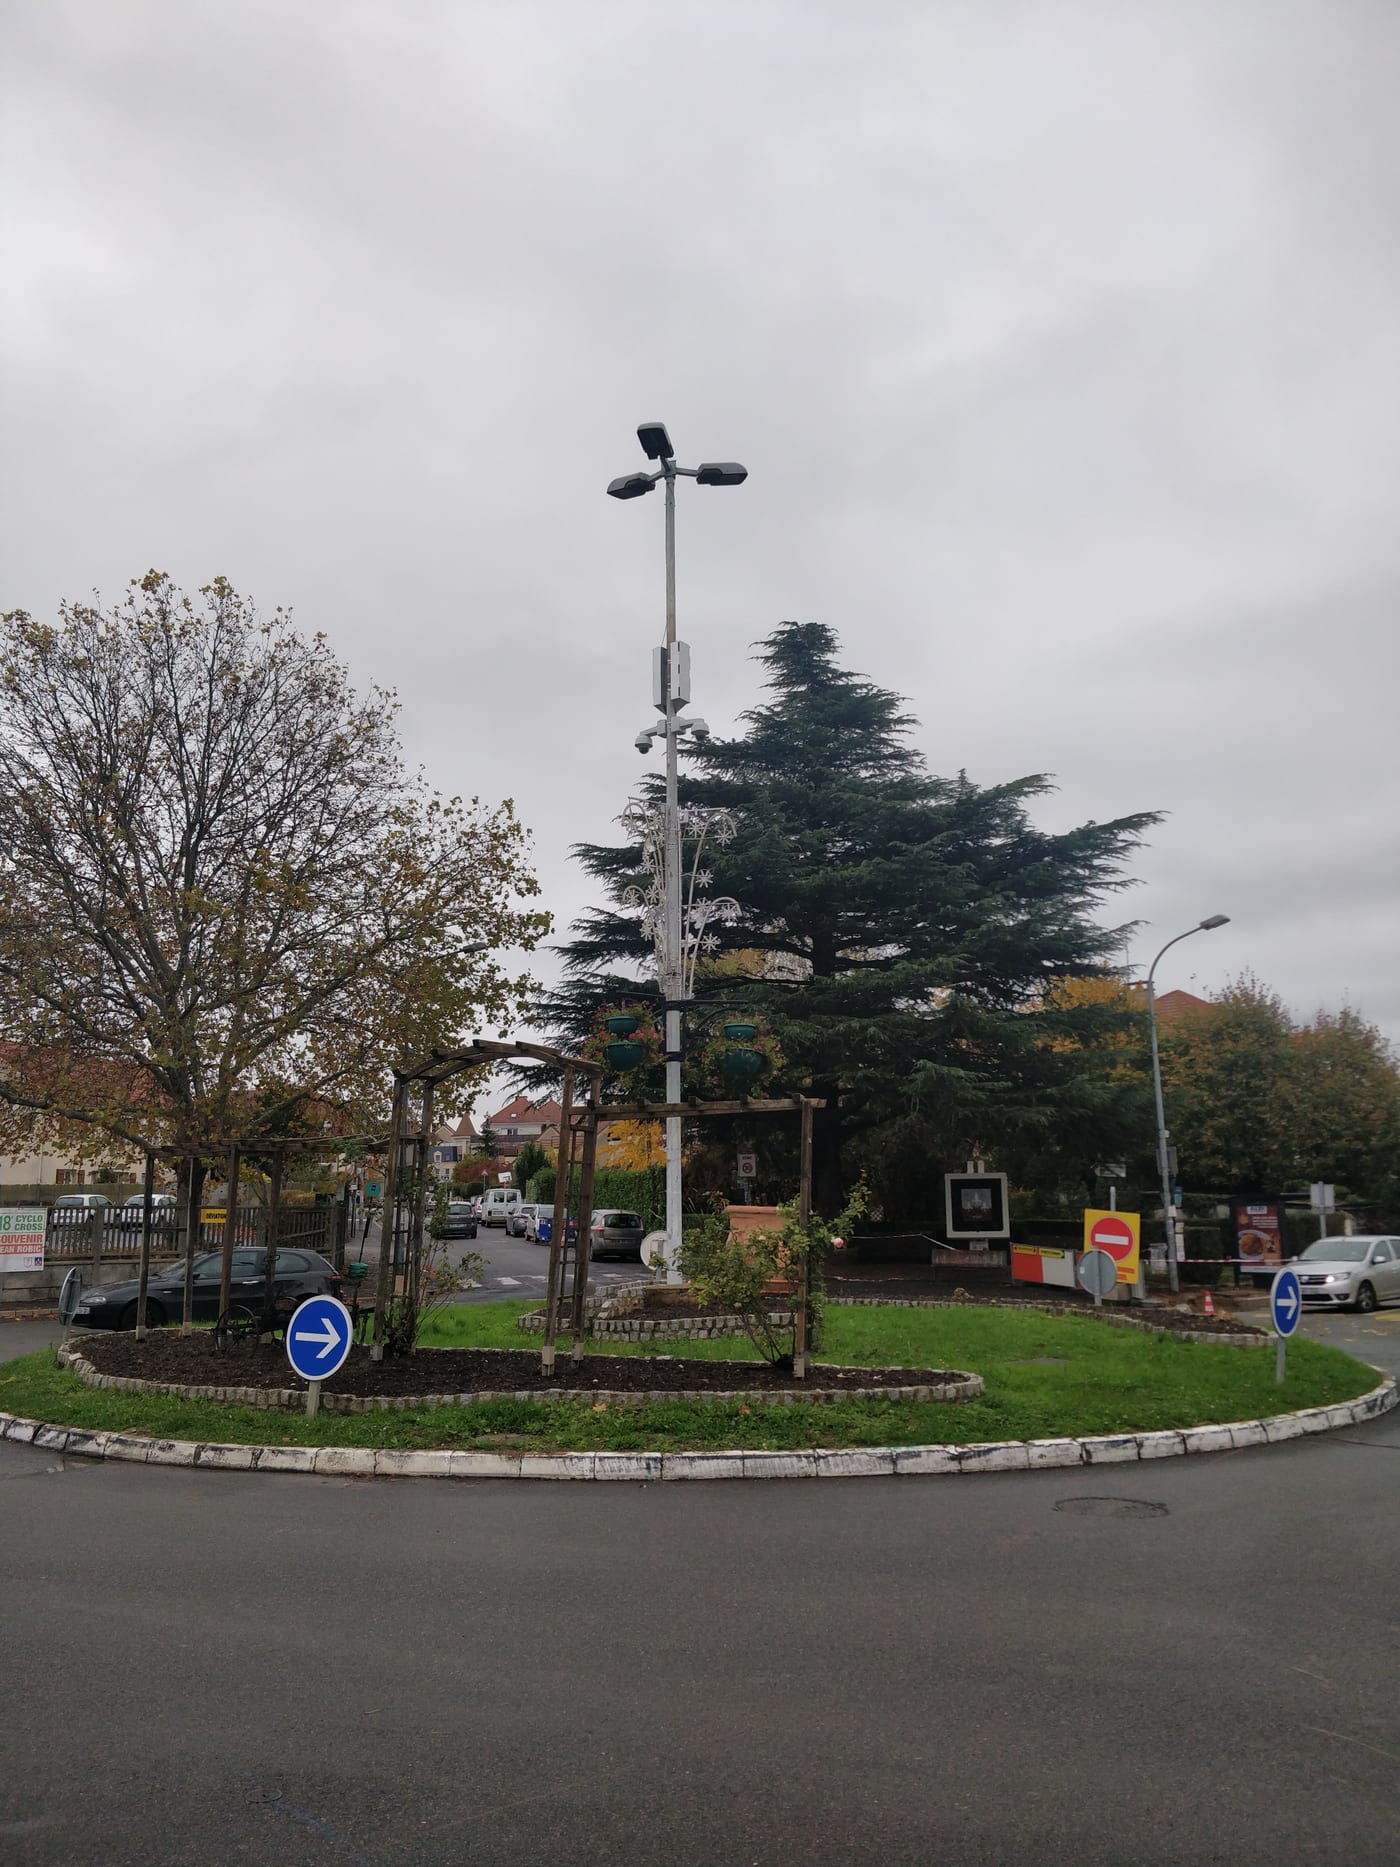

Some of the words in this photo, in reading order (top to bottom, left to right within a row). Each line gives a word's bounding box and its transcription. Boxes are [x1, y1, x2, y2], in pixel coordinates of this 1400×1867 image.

[16, 1214, 43, 1222] CYCLO
[14, 1223, 43, 1231] CROSS
[0, 1233, 43, 1244] OUVENIR
[16, 1245, 43, 1253] ROBIC
